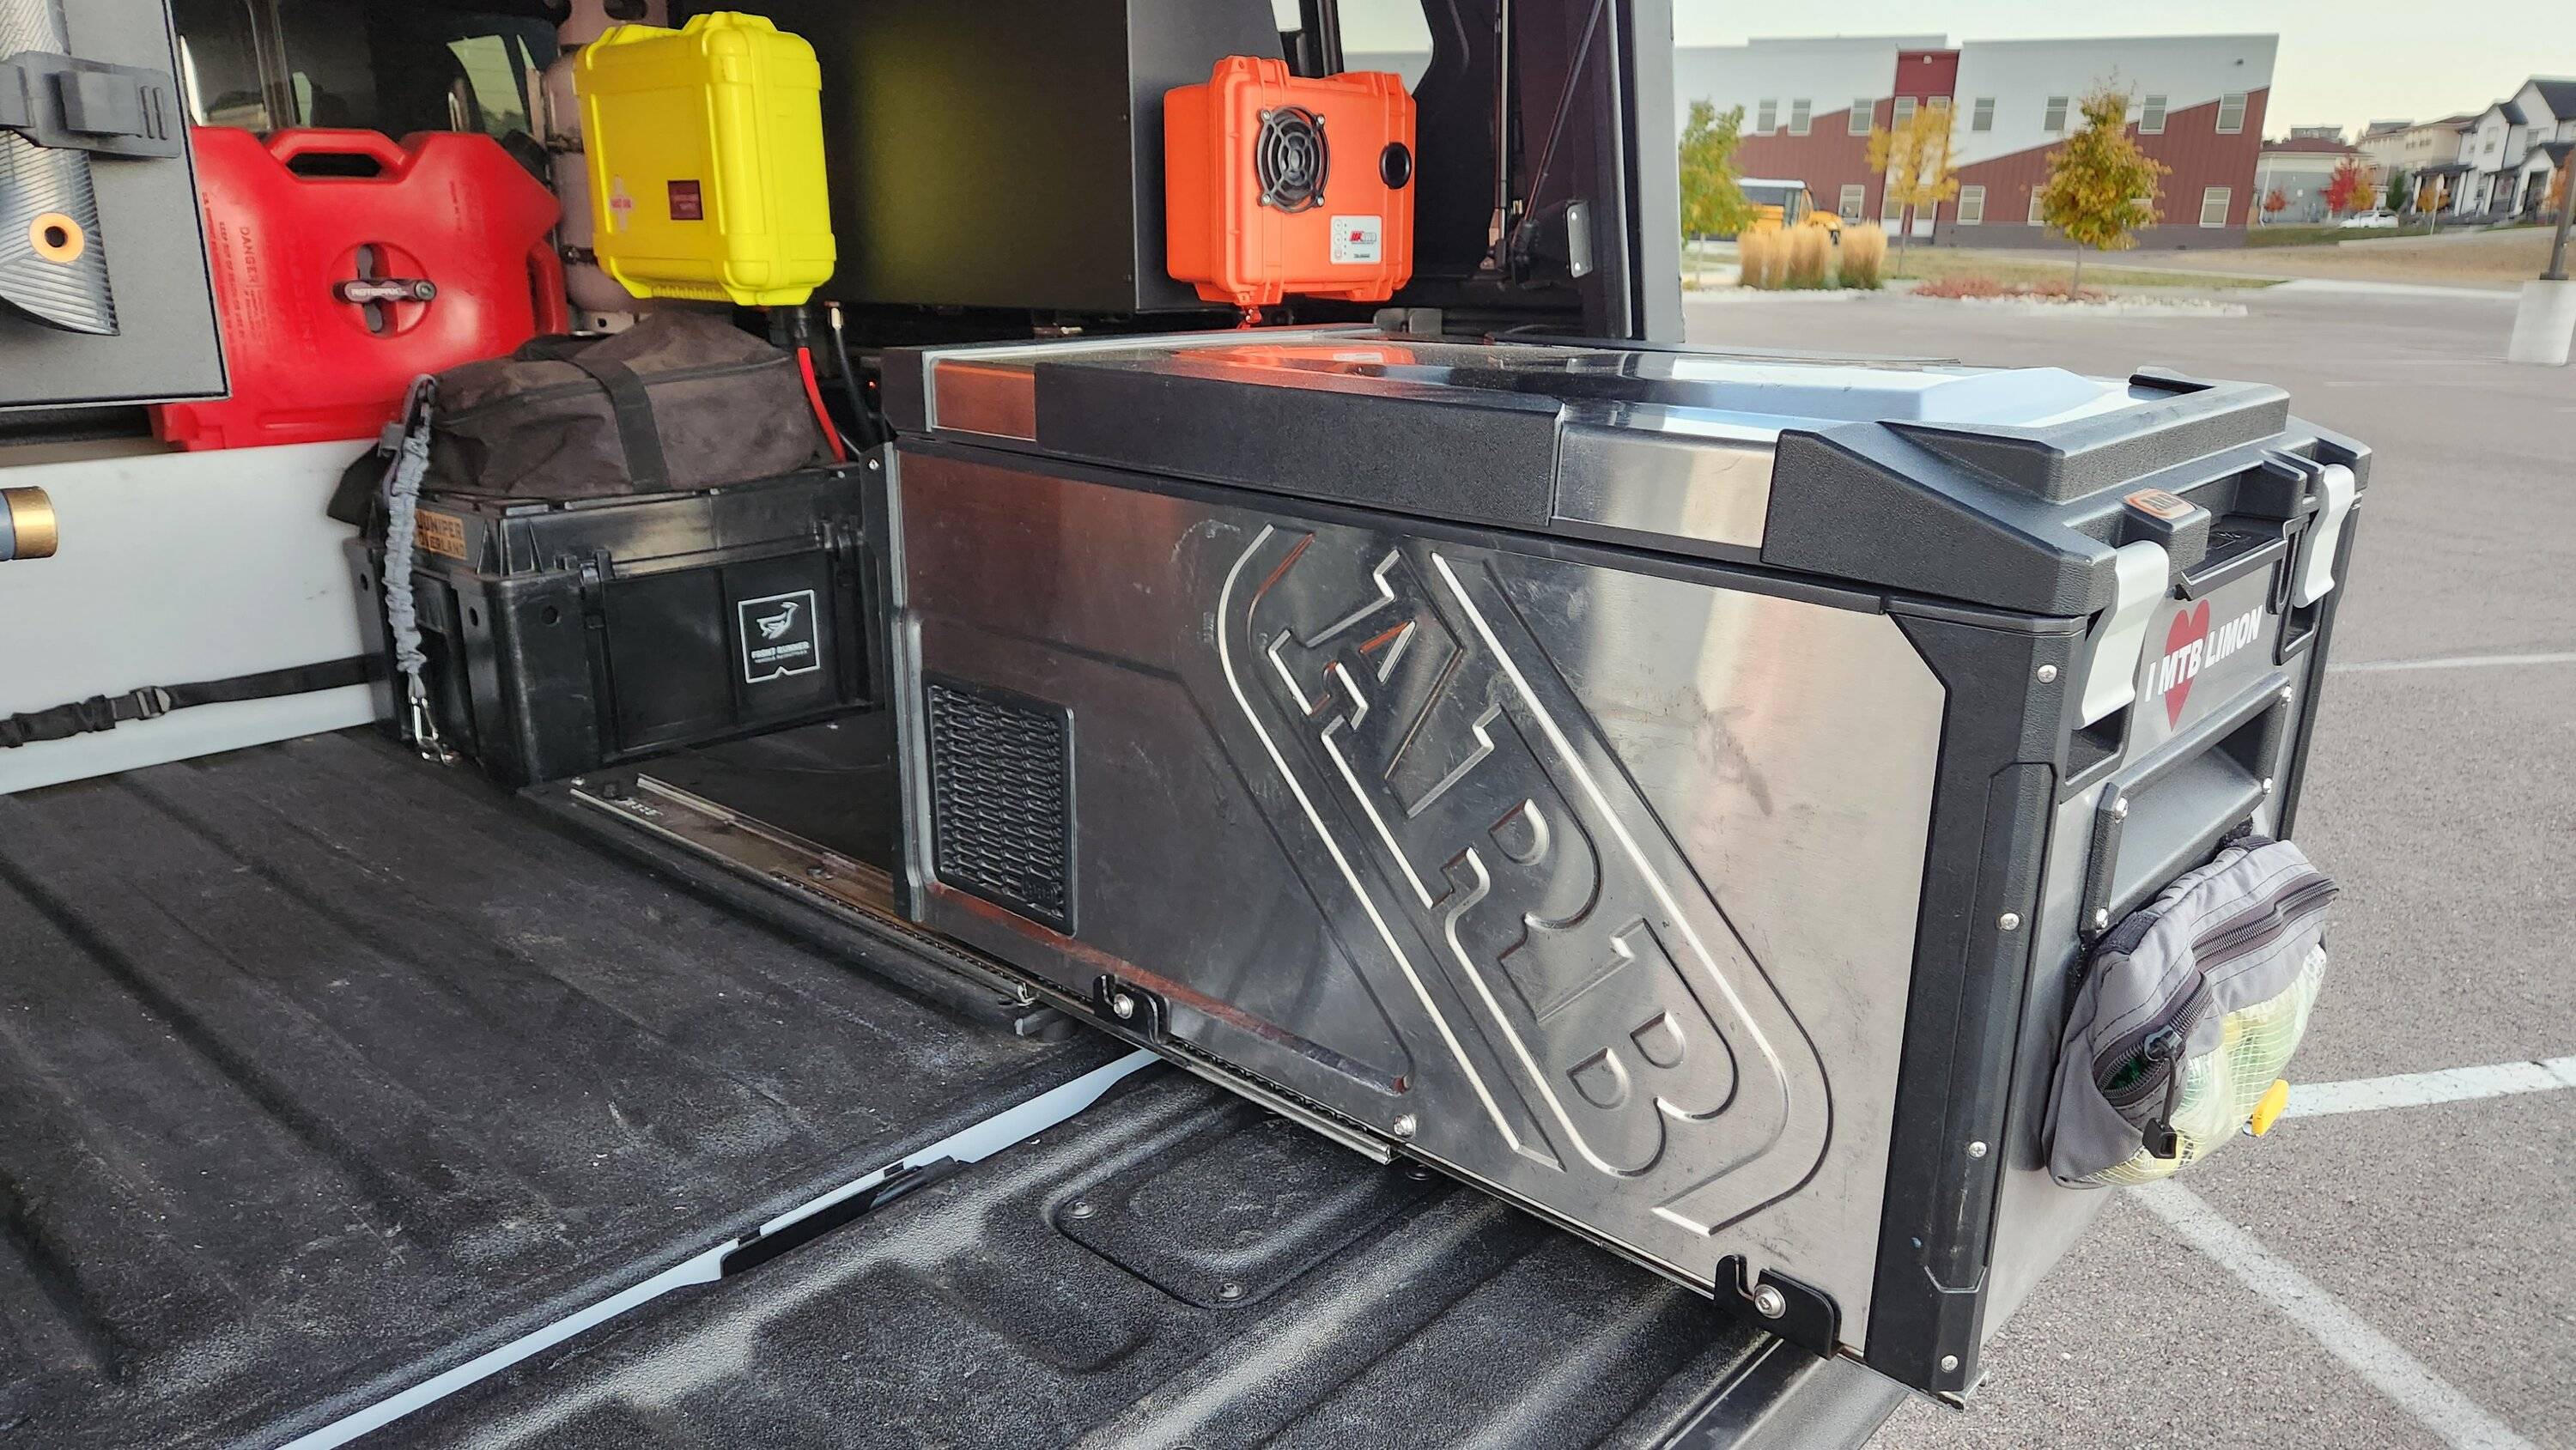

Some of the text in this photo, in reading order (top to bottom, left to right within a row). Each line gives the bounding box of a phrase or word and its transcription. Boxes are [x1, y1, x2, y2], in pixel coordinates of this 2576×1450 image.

[240, 227, 258, 283] DANGER
[2145, 604, 2263, 702] I MTB LIMON
[1268, 549, 1740, 1179] ARB
